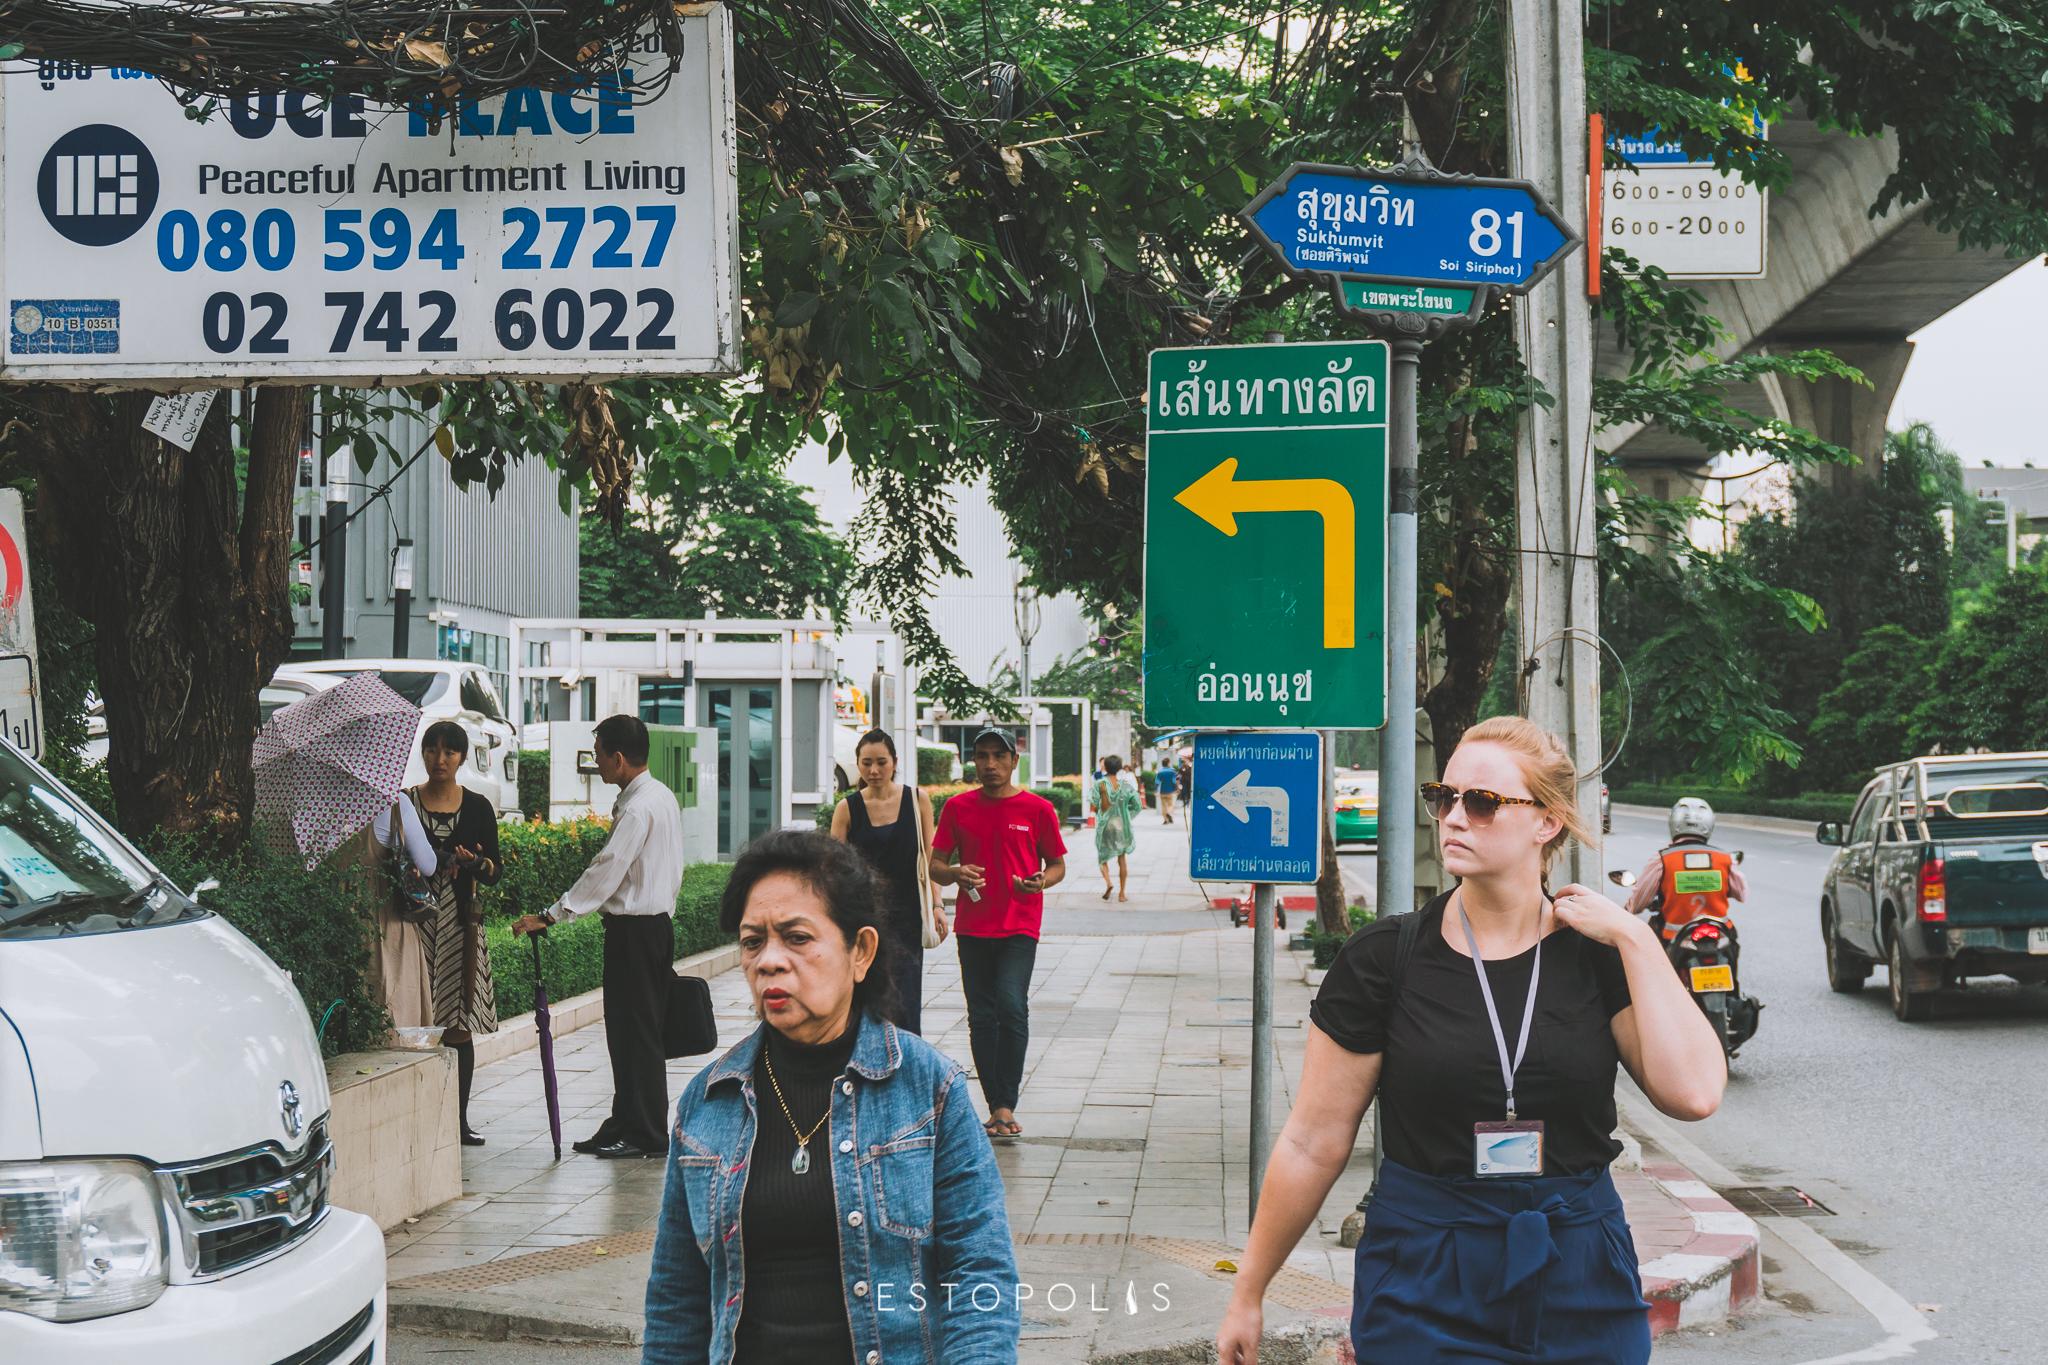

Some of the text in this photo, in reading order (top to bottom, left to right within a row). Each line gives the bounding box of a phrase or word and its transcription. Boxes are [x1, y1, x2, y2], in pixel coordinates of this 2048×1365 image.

[199, 160, 686, 199] Peaceful Apartment Living
[1298, 184, 1415, 233] สุขุมวิท
[156, 204, 677, 272] 080 594 2727
[1297, 228, 1384, 249] Sukhumvit
[1468, 207, 1524, 259] 81
[1440, 259, 1460, 271] Soi
[202, 288, 676, 353] 02 742 6022
[1362, 288, 1453, 310] เขตพระโขนง
[1159, 357, 1376, 417] เส้นทางลัด
[1198, 662, 1313, 716] อ่อนนุช
[1200, 740, 1313, 765] หยุดให้ทางก่อนผ่าน
[1197, 848, 1311, 873] เลี้ยวซ้ายผ่านตลอด
